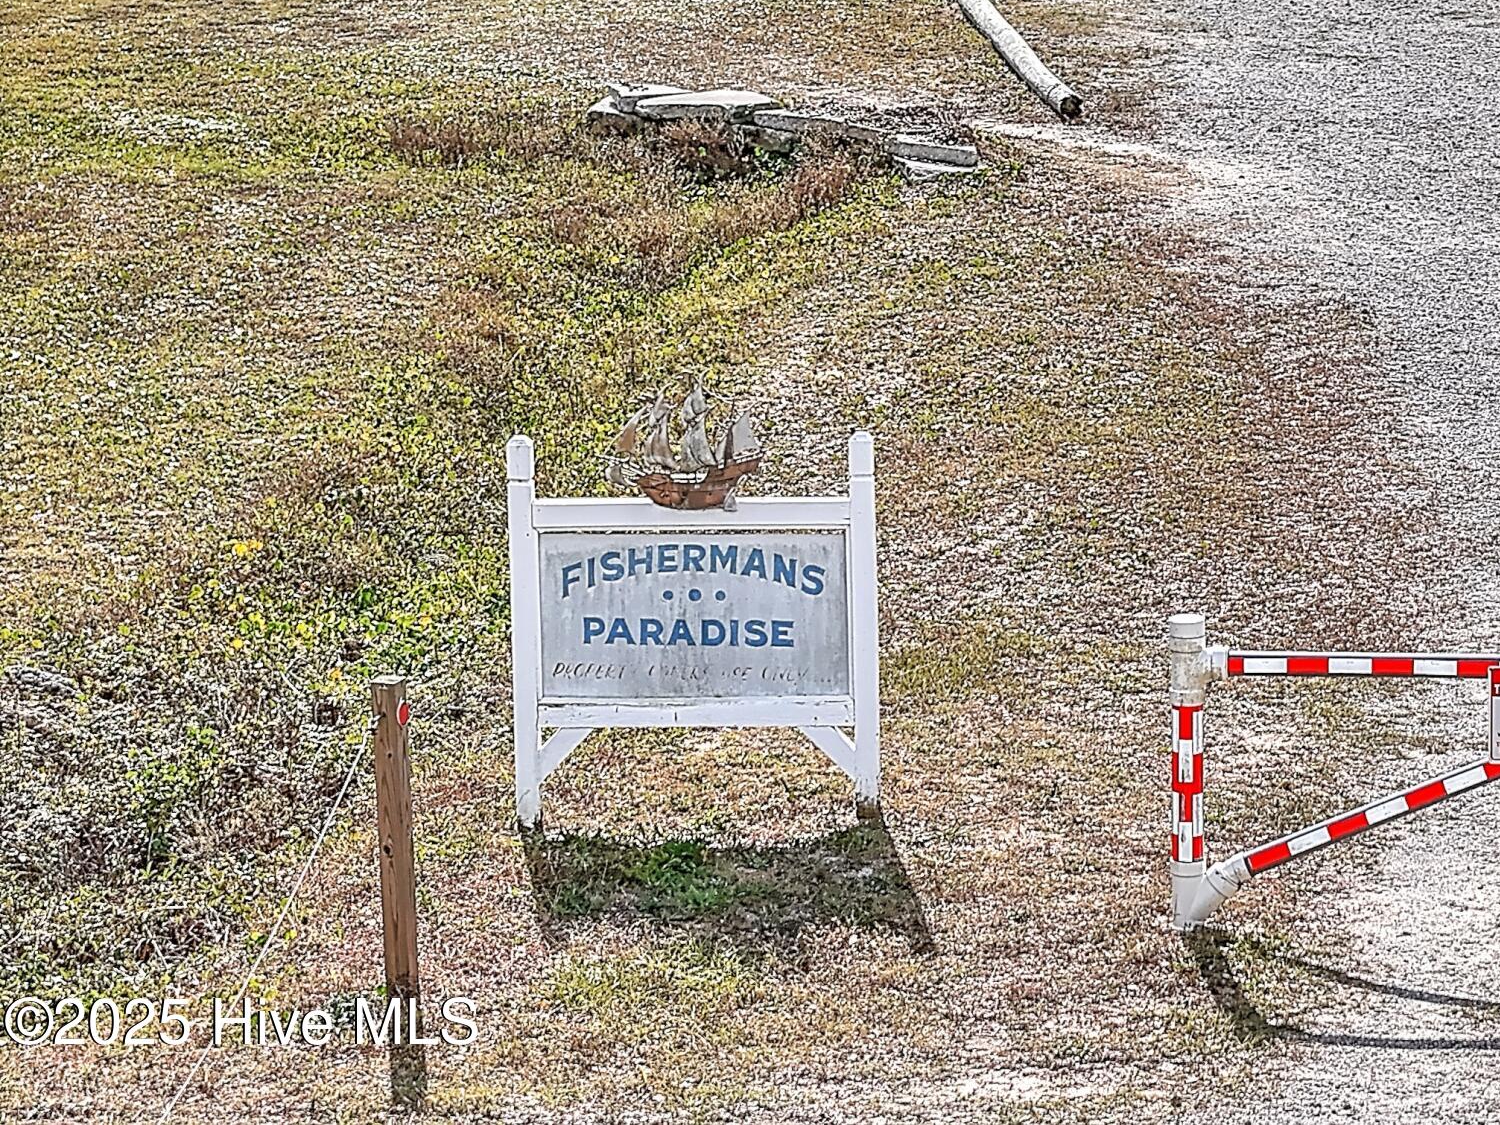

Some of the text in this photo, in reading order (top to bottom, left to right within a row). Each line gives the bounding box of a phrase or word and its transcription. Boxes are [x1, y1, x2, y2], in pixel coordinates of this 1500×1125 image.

[561, 544, 826, 598] FISHERMANS
[583, 617, 795, 647] PARADISE
[553, 662, 638, 680] PROPERT
